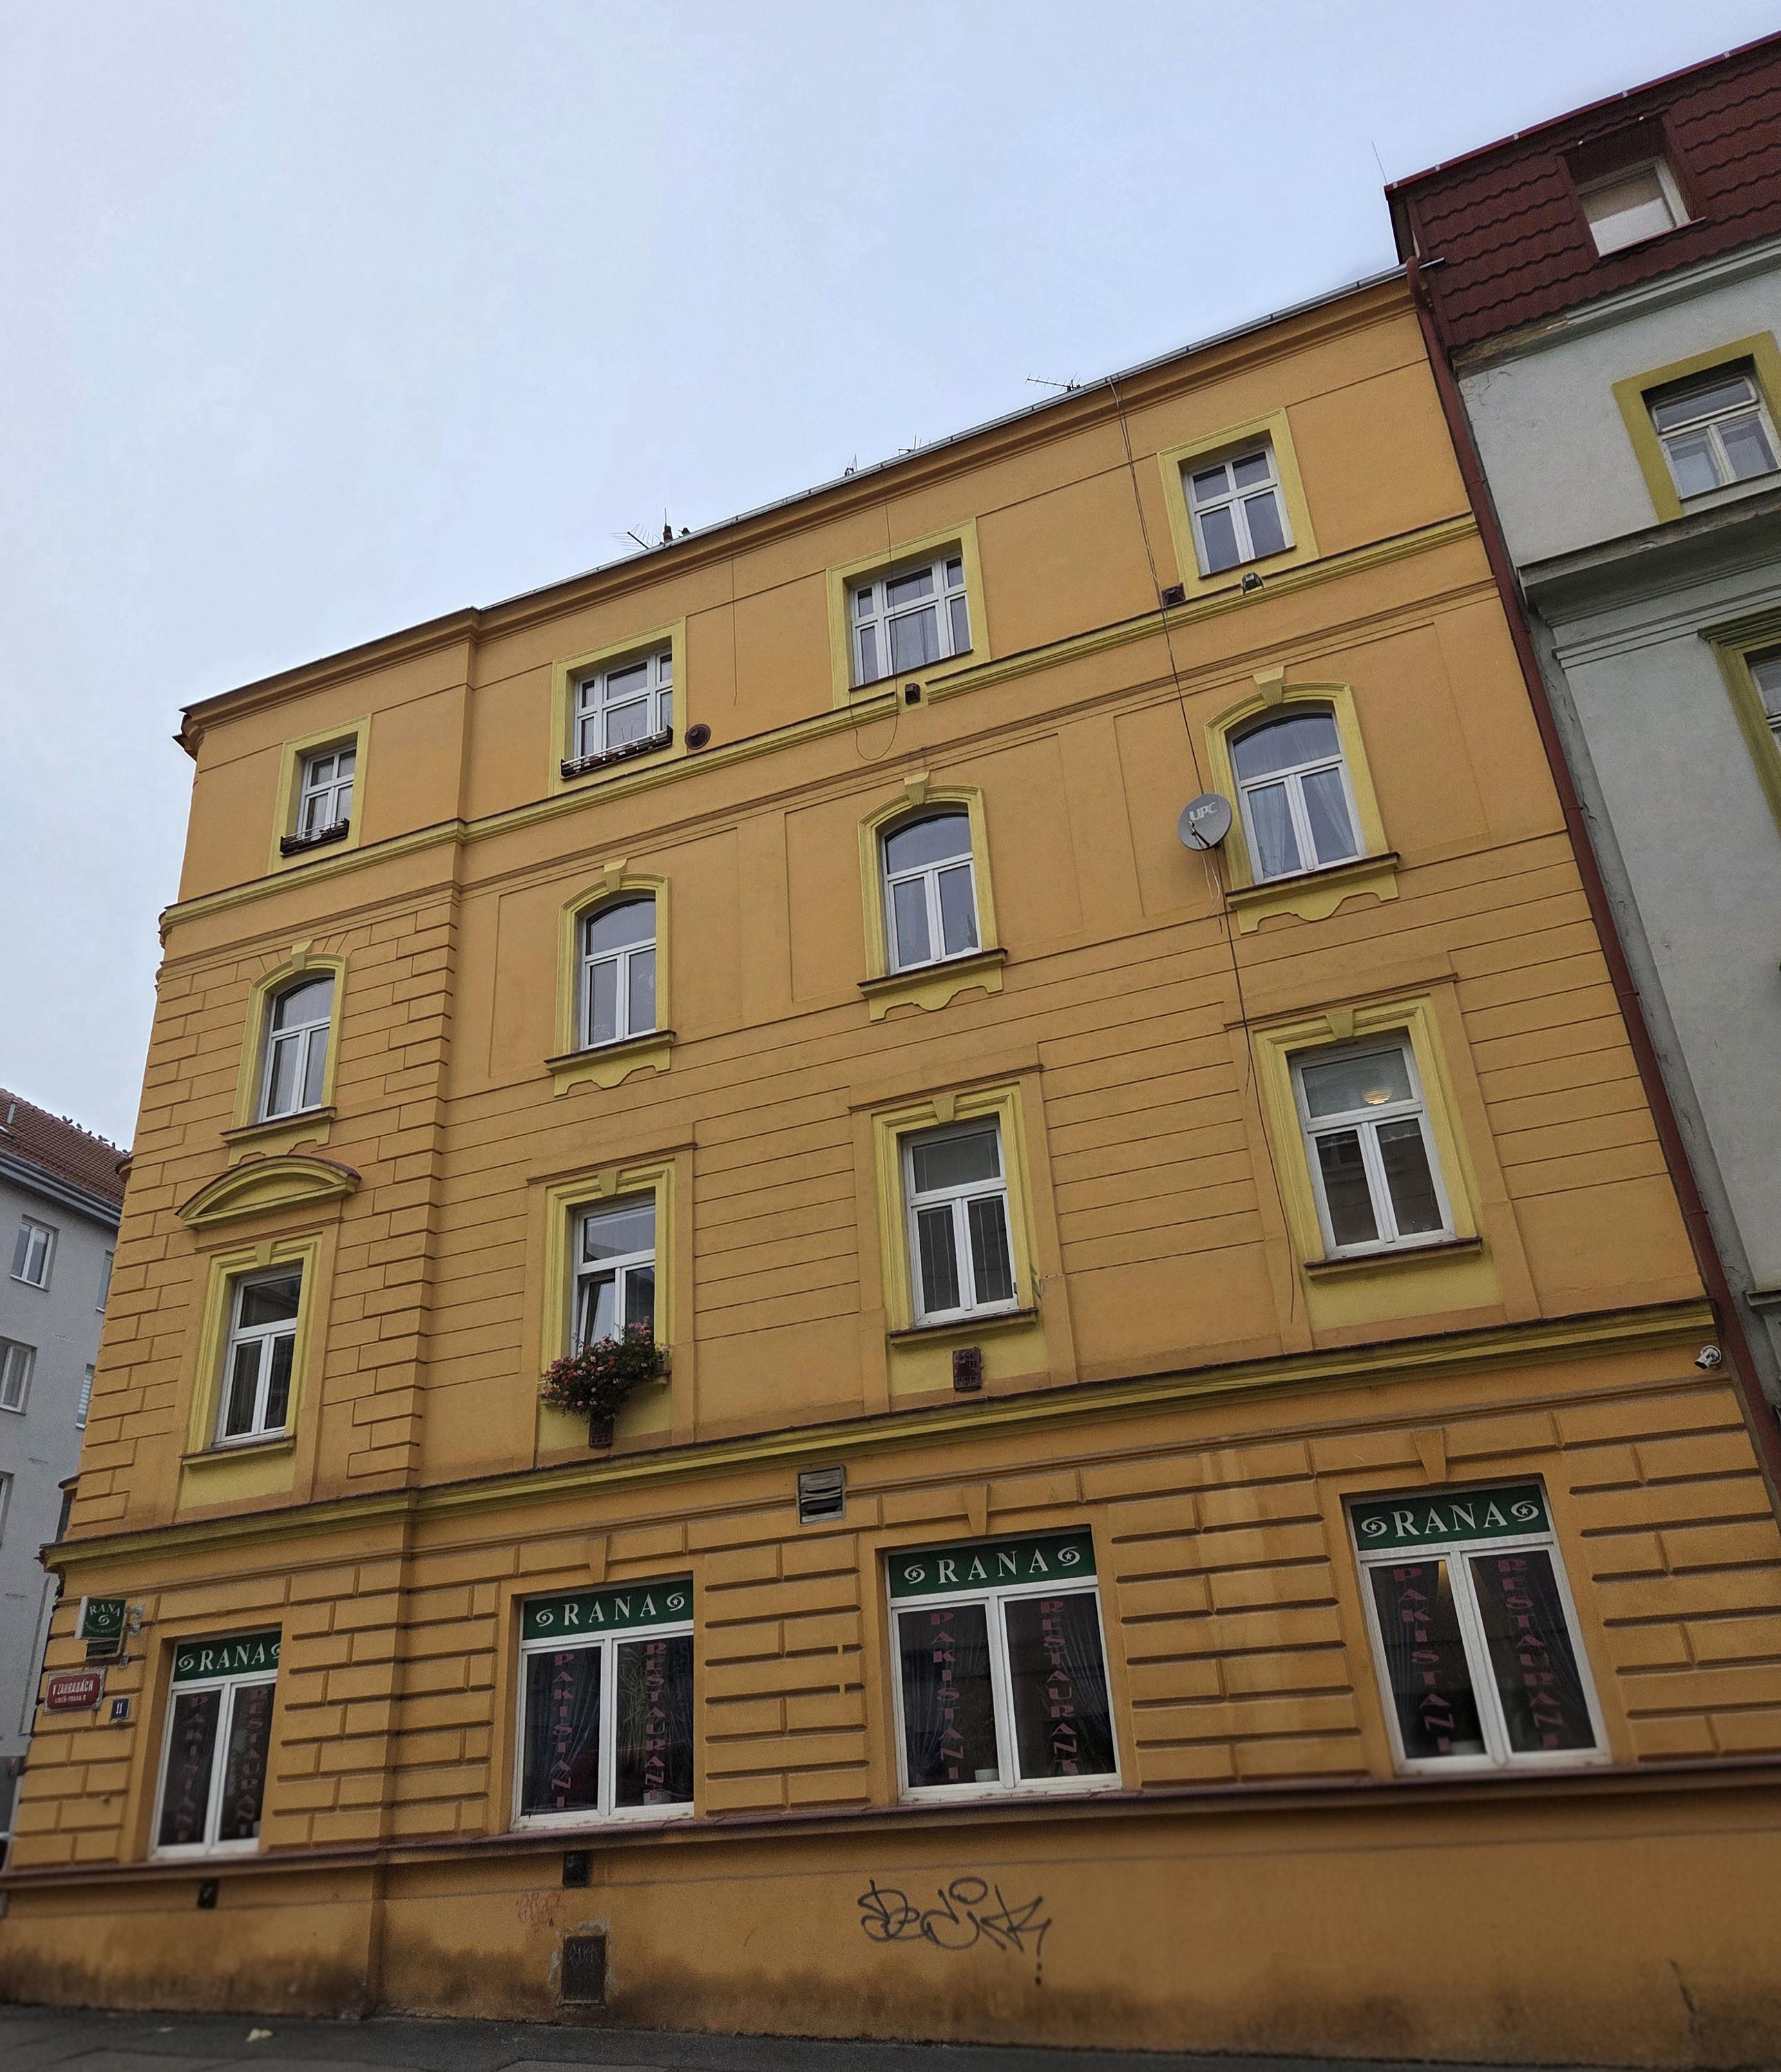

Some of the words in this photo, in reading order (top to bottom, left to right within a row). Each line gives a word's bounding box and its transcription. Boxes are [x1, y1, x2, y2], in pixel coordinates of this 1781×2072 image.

[1189, 802, 1217, 821] UPC
[1390, 1500, 1509, 1538] RANA
[936, 1548, 1049, 1584] RANA
[89, 1604, 121, 1616] RANA
[564, 1593, 657, 1626] RANA
[198, 1642, 265, 1672] RANA
[1393, 1566, 1455, 1754] PAKISTANI
[1498, 1557, 1565, 1749] RESTAURANT
[53, 1685, 57, 1696] V
[930, 1611, 964, 1781] PAKISTANI
[1040, 1600, 1080, 1776] RESTAURANT
[115, 1702, 124, 1714] 11
[643, 1642, 668, 1801] RESTAURANT
[551, 1652, 575, 1808] PAKISTANI
